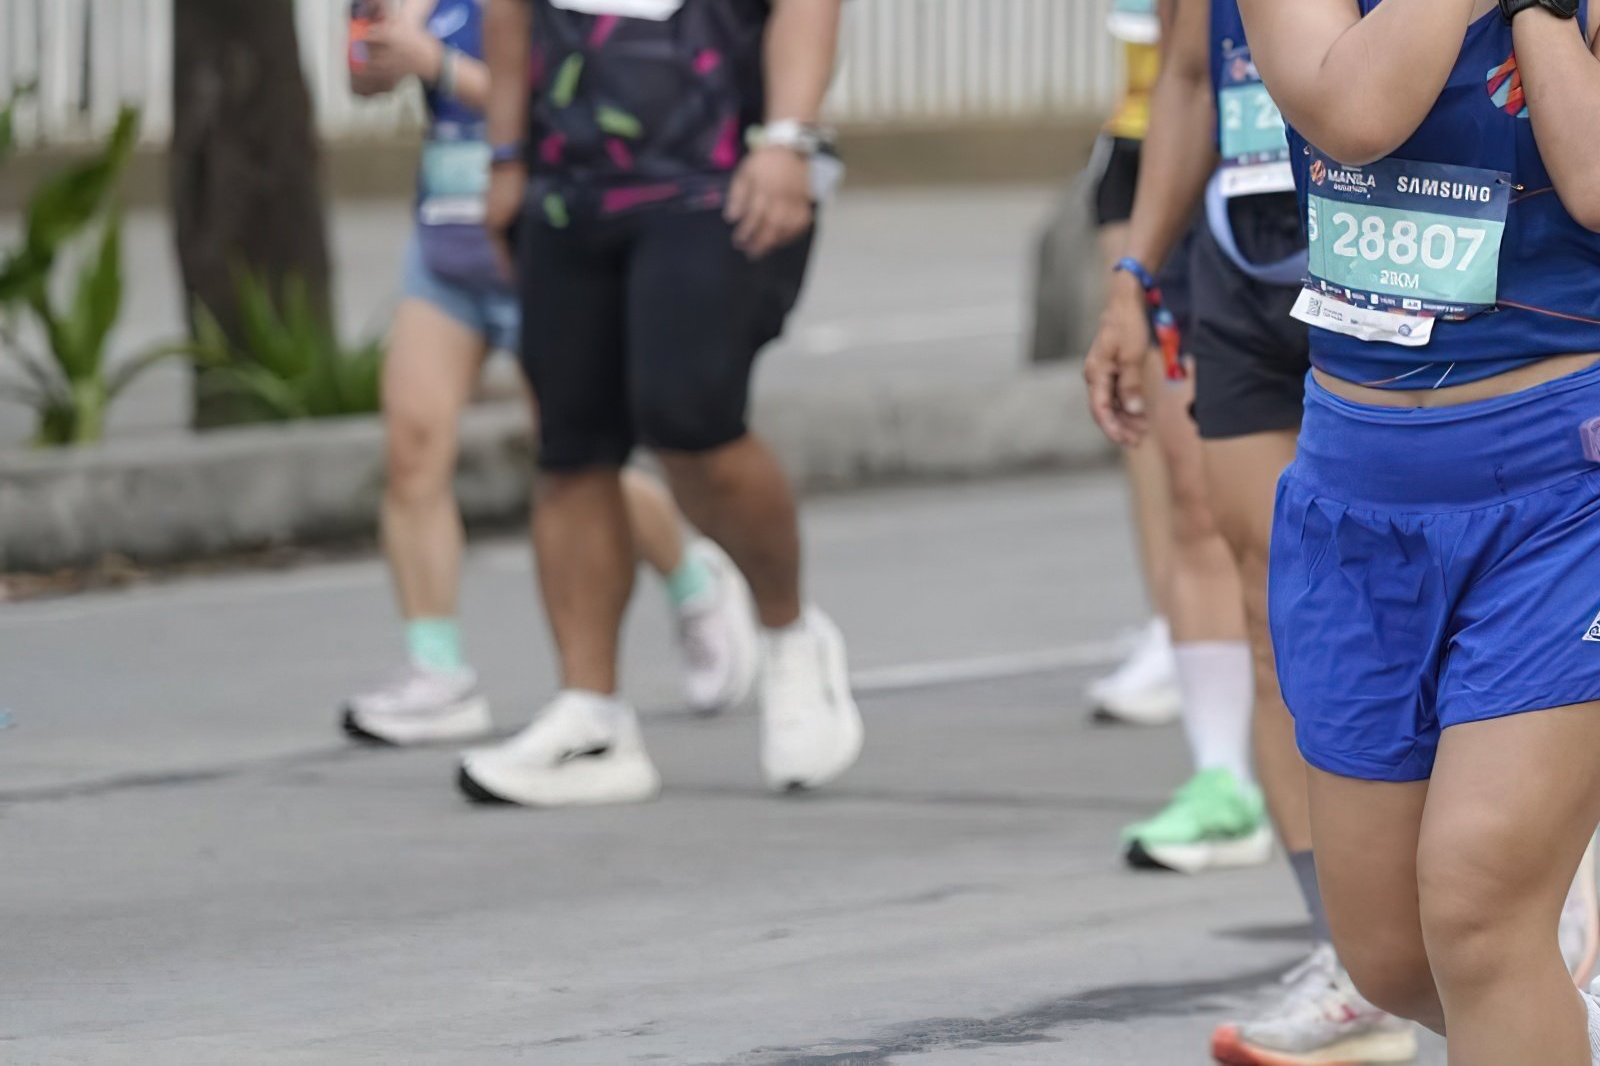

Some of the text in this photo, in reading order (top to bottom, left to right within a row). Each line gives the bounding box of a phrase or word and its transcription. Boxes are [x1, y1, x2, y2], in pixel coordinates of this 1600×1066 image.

[1327, 168, 1376, 187] MANILA
[1396, 175, 1491, 202] SAMSUNG
[1331, 212, 1486, 271] 28807
